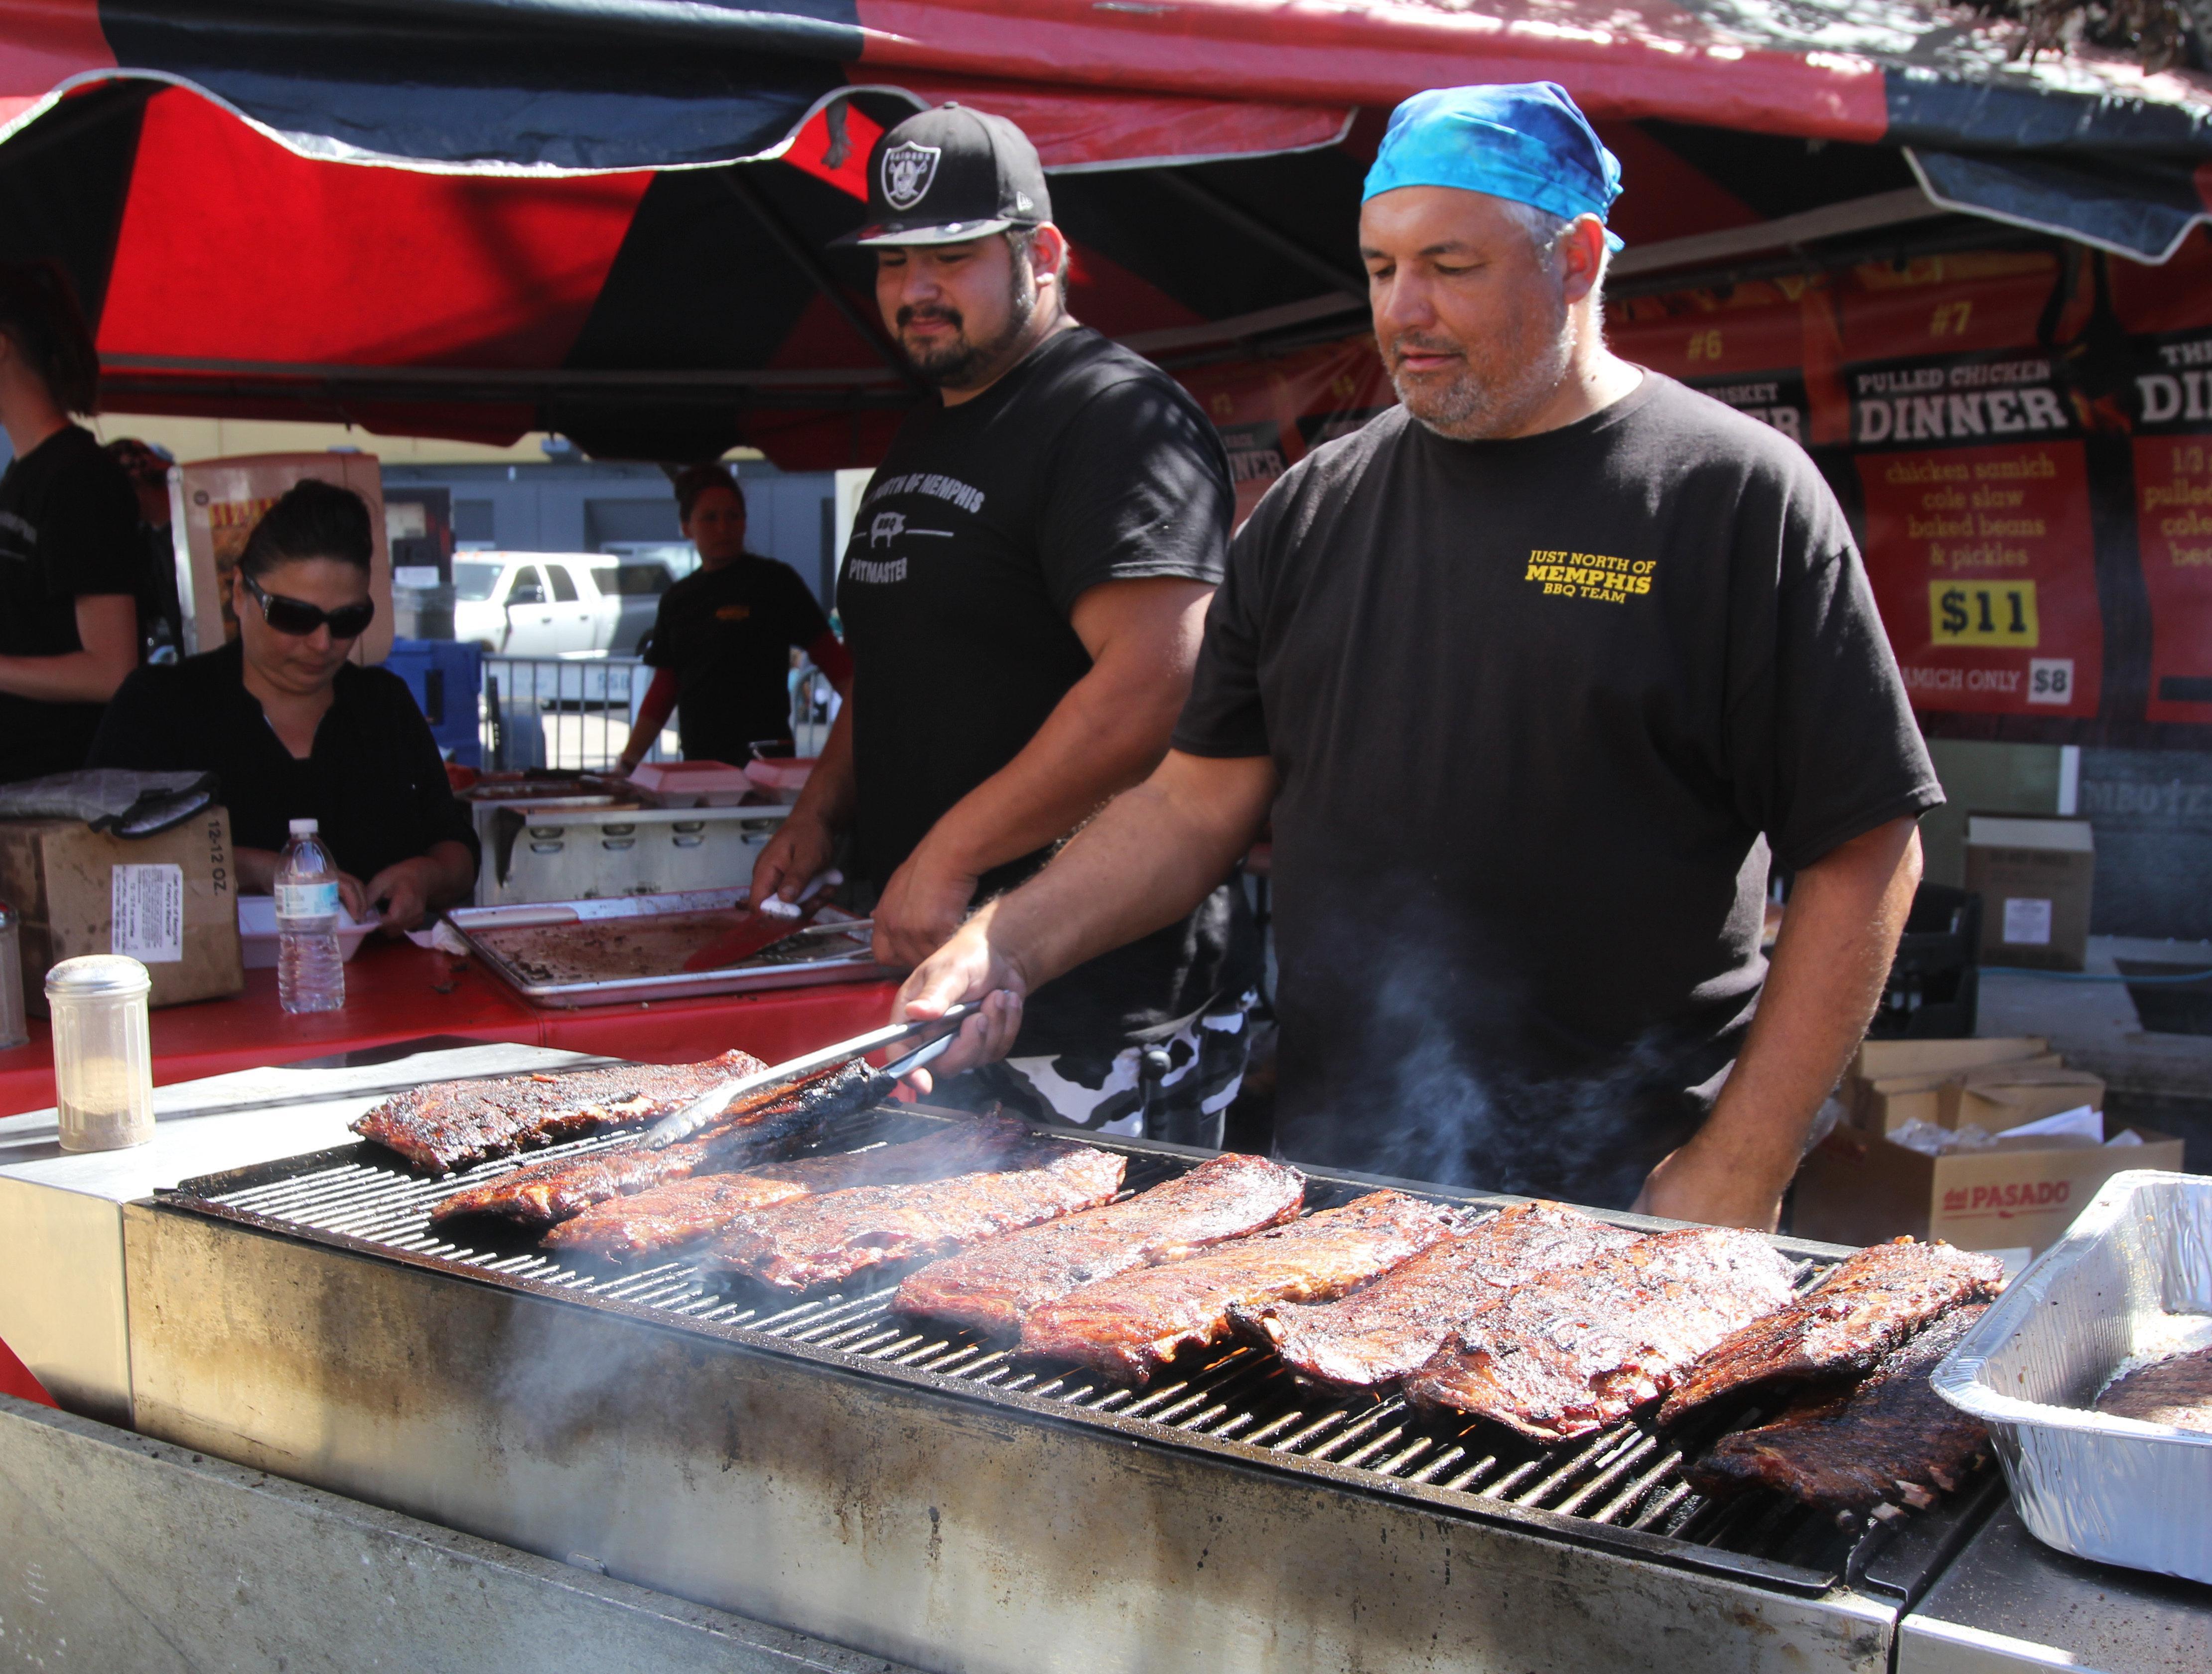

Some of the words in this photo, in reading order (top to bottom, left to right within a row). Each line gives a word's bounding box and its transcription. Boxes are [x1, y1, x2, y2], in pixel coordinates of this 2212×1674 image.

[890, 151, 931, 161] RAIDERS
[1931, 300, 1972, 336] #7
[1687, 329, 1723, 361] #6
[1858, 368, 1943, 395] PULLED
[1950, 359, 2051, 387] CHICKEN
[1858, 387, 2069, 443] DINNER
[1886, 459, 1969, 484] chicken
[1974, 452, 2056, 479] samich
[904, 473, 926, 493] OF
[918, 473, 985, 514] MEMPHIS
[1922, 485, 1967, 510] cole
[1972, 483, 2025, 509] slaw
[877, 516, 896, 532] BBQ
[1908, 513, 1974, 539] baked
[1978, 513, 2046, 538] beans
[849, 557, 908, 584] PITMASTER
[1528, 550, 1567, 563] JUST
[1569, 553, 1630, 571] NORTH
[1632, 560, 1657, 573] OF
[1952, 541, 2029, 571] pickles
[1525, 564, 1652, 594] MEMPHIS
[1543, 582, 1576, 597] BBQ
[1580, 585, 1626, 604] TEAM
[1941, 587, 2027, 636] $11
[1968, 669, 2021, 692] ONLY
[2034, 668, 2068, 694] $8
[208, 821, 224, 863] 12-12
[212, 867, 227, 896] OZ.
[1971, 1180, 2071, 1210] PASADO
